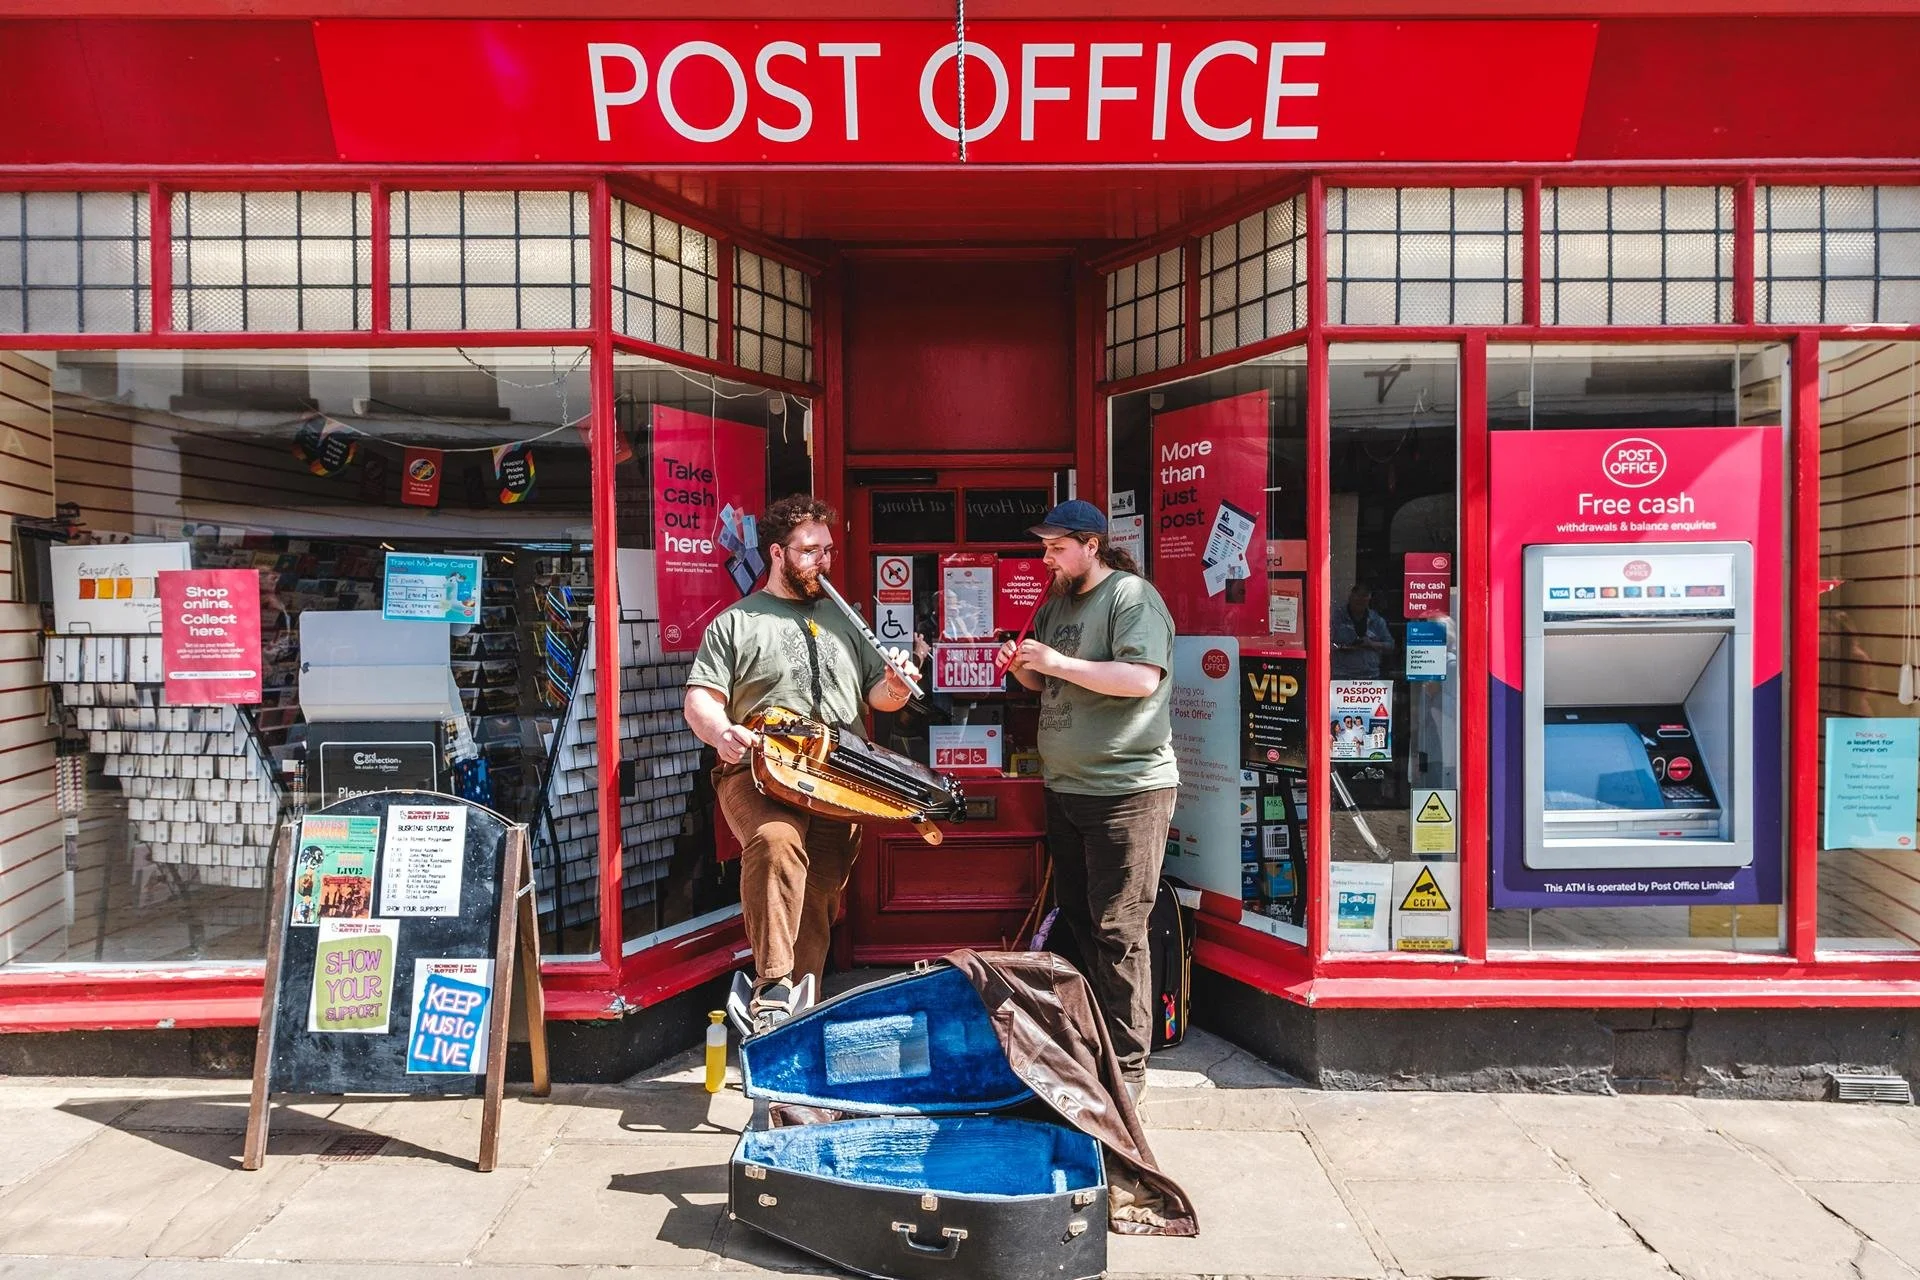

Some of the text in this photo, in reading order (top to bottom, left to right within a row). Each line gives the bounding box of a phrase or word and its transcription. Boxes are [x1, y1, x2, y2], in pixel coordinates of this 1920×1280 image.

[588, 41, 1326, 143] POST OFFICE
[1161, 439, 1213, 463] More
[1618, 450, 1653, 462] POST
[503, 460, 524, 468] Happy
[506, 466, 524, 474] Pride
[663, 458, 713, 483] Take
[1610, 462, 1657, 475] OFFICE
[508, 472, 524, 480] from
[1160, 464, 1205, 486] than
[664, 488, 715, 508] cash
[1160, 486, 1198, 510] just
[1579, 492, 1695, 515] Free cash
[664, 511, 701, 530] out
[1160, 510, 1205, 533] post
[1556, 520, 1717, 533] withdrawals & balance enquiries
[664, 531, 713, 555] here
[417, 560, 450, 569] Money
[450, 561, 474, 569] Card
[1410, 581, 1446, 590] free cash
[185, 586, 229, 601] Shop
[1410, 592, 1443, 600] machine
[183, 599, 233, 610] online.
[1409, 602, 1427, 611] here
[181, 614, 237, 625] Collect
[190, 626, 228, 637] here.
[945, 662, 994, 687] CLOSED
[1204, 664, 1227, 672] OFFICE
[1172, 686, 1204, 697] ything you
[1248, 672, 1299, 704] VIP
[1336, 688, 1388, 696] PASSPORT
[1178, 699, 1217, 709] expect from
[1343, 696, 1382, 704] READY?
[1175, 708, 1190, 719] Post
[1261, 704, 1285, 712] DELIVERY
[1544, 880, 1735, 894] This ATM is operated by Post Office Limited
[1414, 899, 1437, 908] CCTV
[325, 949, 382, 976] SHOW
[325, 976, 383, 1005] YOUR
[426, 983, 482, 1015] KEEP
[325, 1003, 382, 1022] SUPPORT
[420, 1013, 476, 1040] MUSIC
[414, 1034, 469, 1066] LIVE
